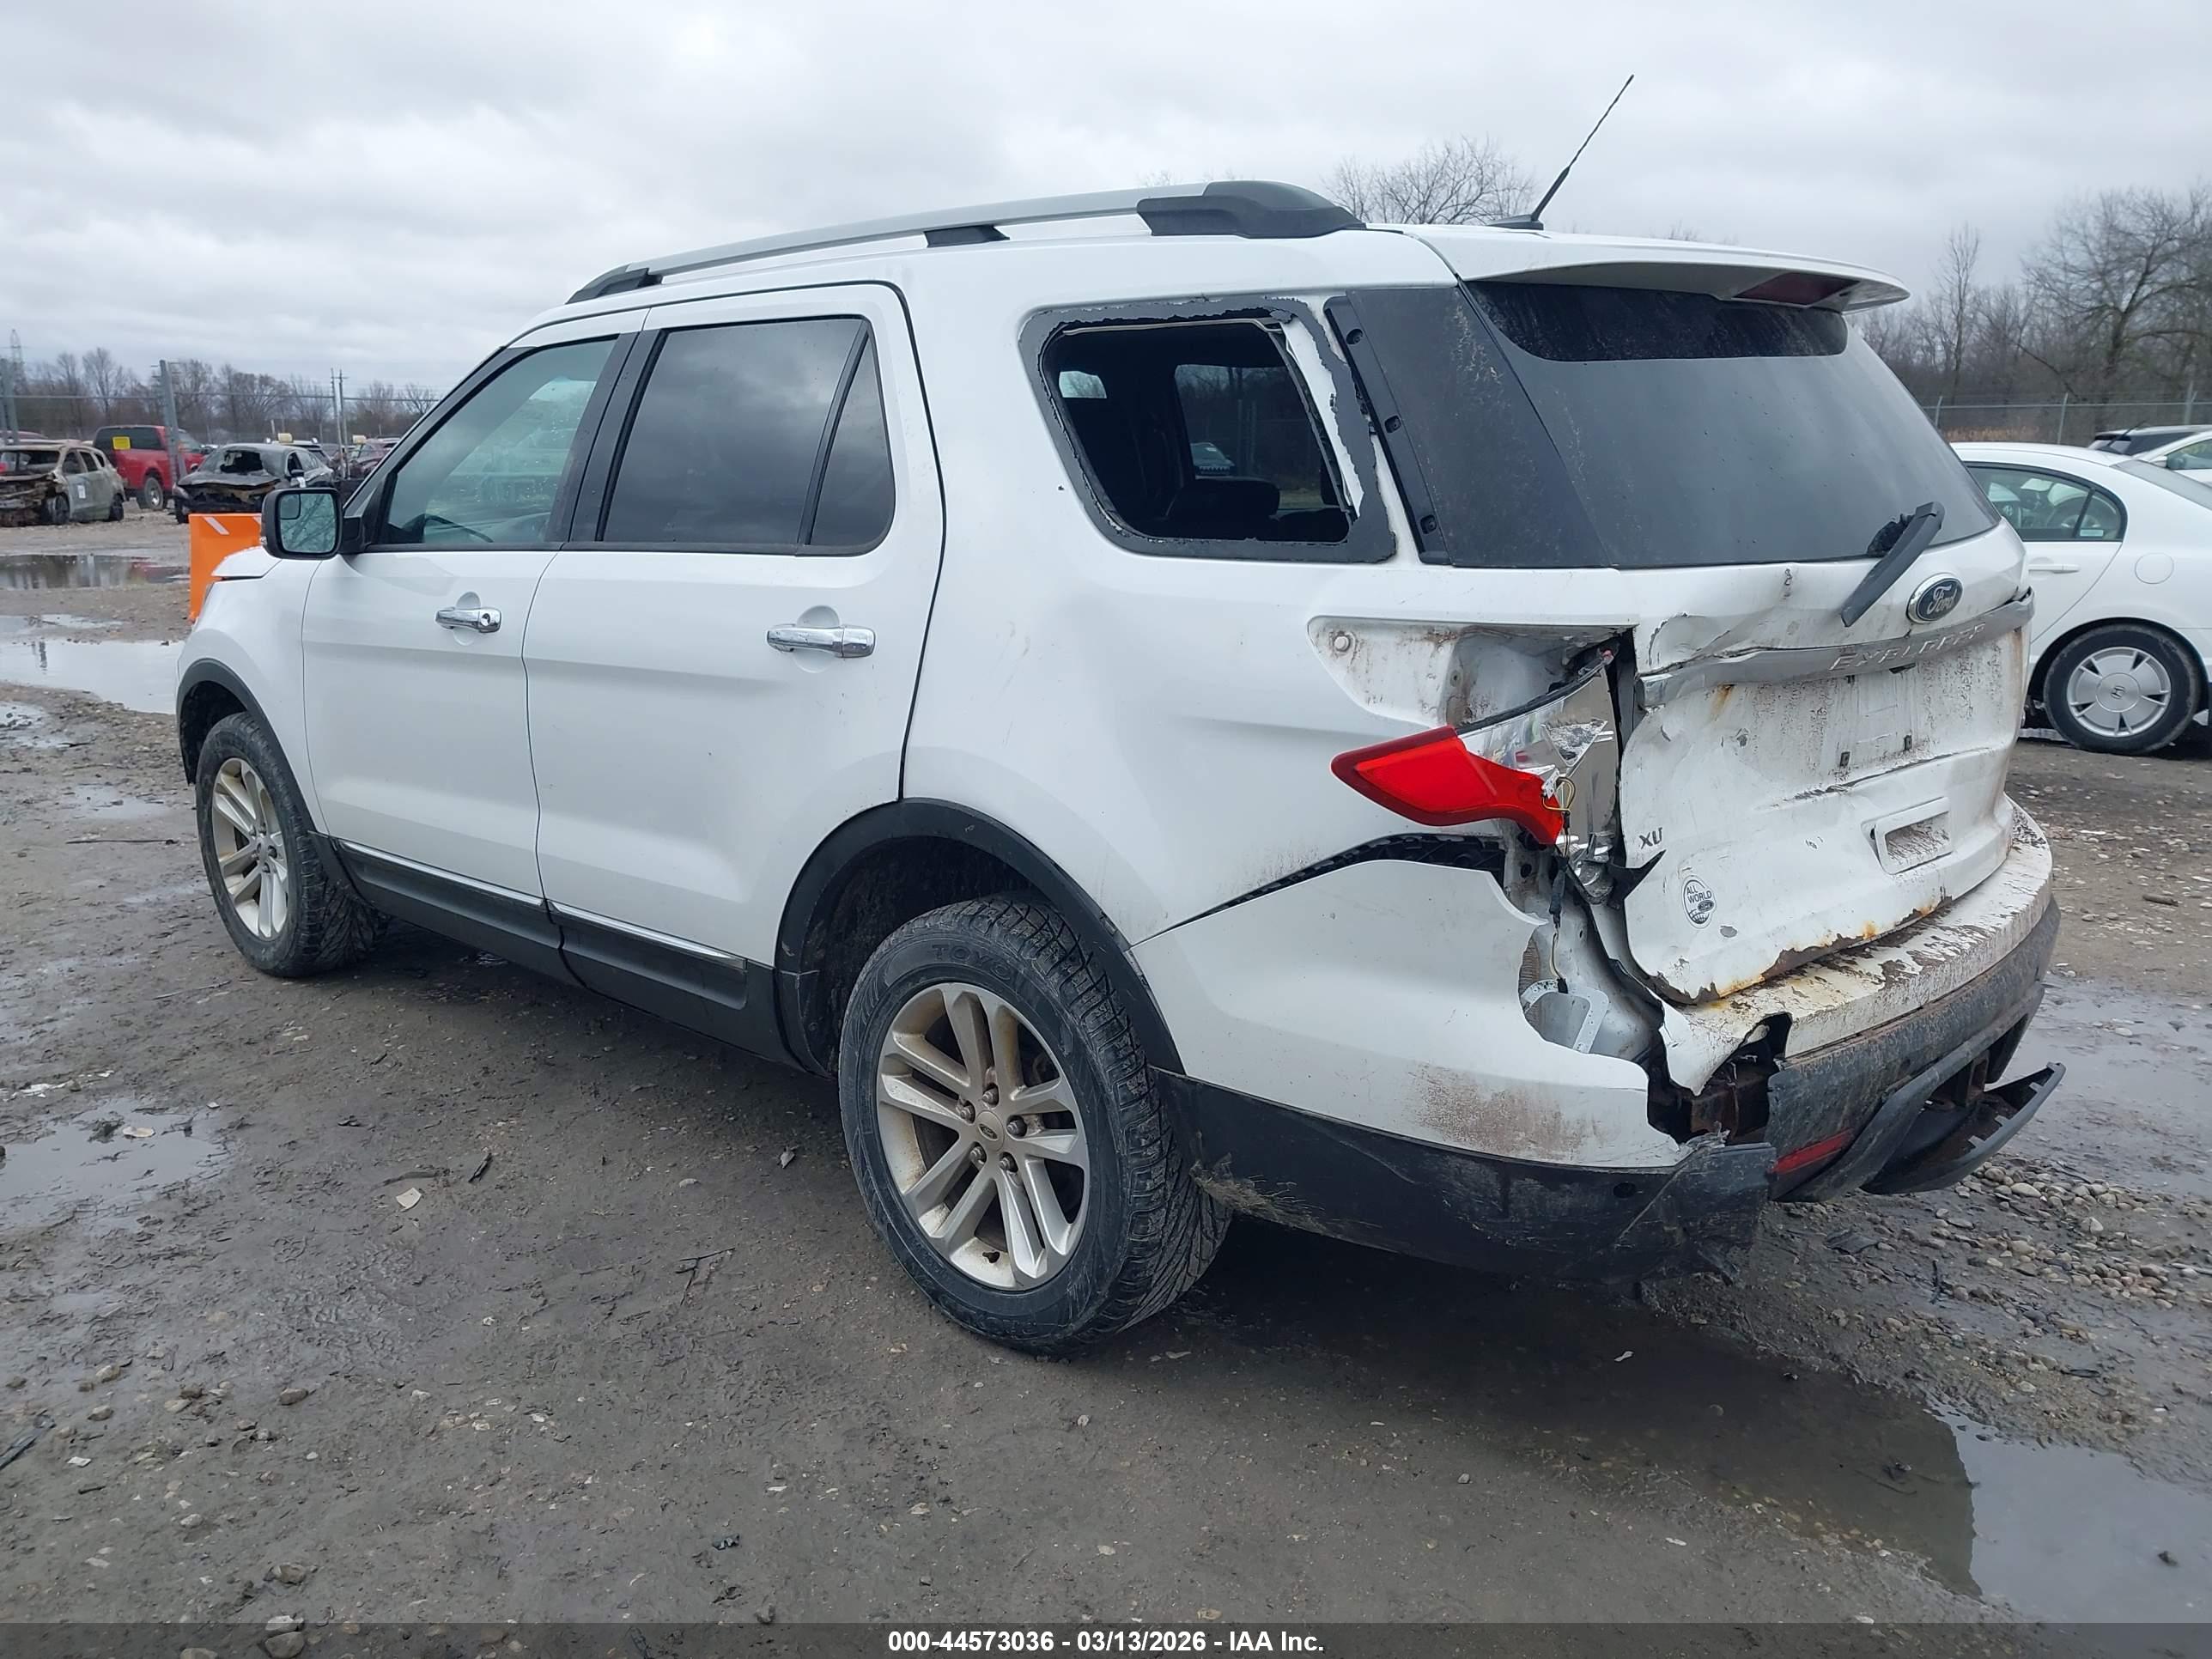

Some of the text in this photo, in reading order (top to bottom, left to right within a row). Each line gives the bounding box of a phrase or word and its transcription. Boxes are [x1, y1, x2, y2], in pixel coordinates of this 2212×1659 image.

[1926, 584, 1959, 616] Ford
[1828, 622, 1986, 672] EXPLORER
[1686, 884, 1698, 896] ALL
[1686, 890, 1713, 904] WORLD
[932, 944, 1012, 981] TOYO
